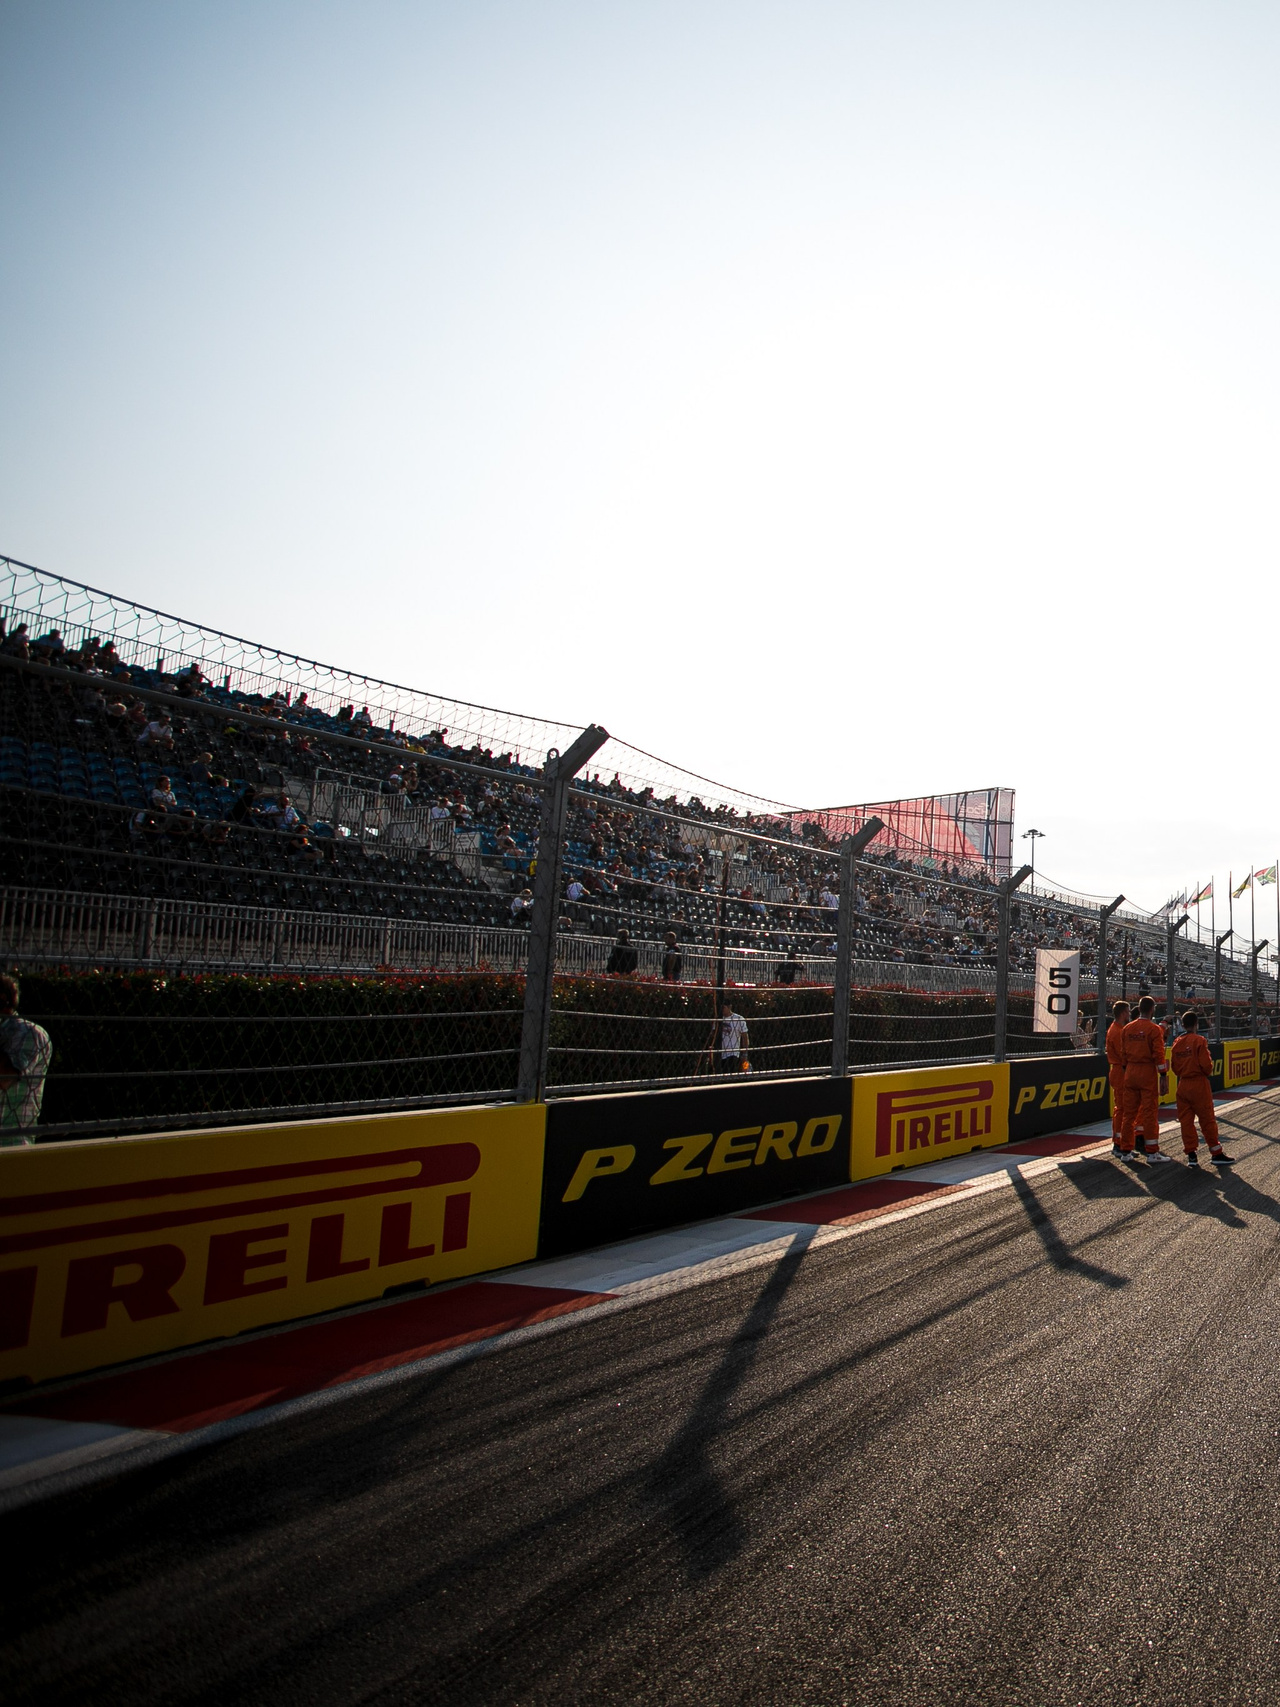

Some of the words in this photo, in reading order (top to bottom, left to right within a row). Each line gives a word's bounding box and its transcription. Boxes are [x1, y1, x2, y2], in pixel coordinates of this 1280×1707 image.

[1048, 967, 1072, 1015] 50
[1229, 1048, 1256, 1080] PIRELLI
[1260, 1052, 1268, 1067] P
[1015, 1086, 1037, 1115] P
[1039, 1076, 1107, 1110] ZERO
[875, 1079, 994, 1158] PIRELLI
[561, 1144, 636, 1203] P
[649, 1113, 843, 1186] ZERO
